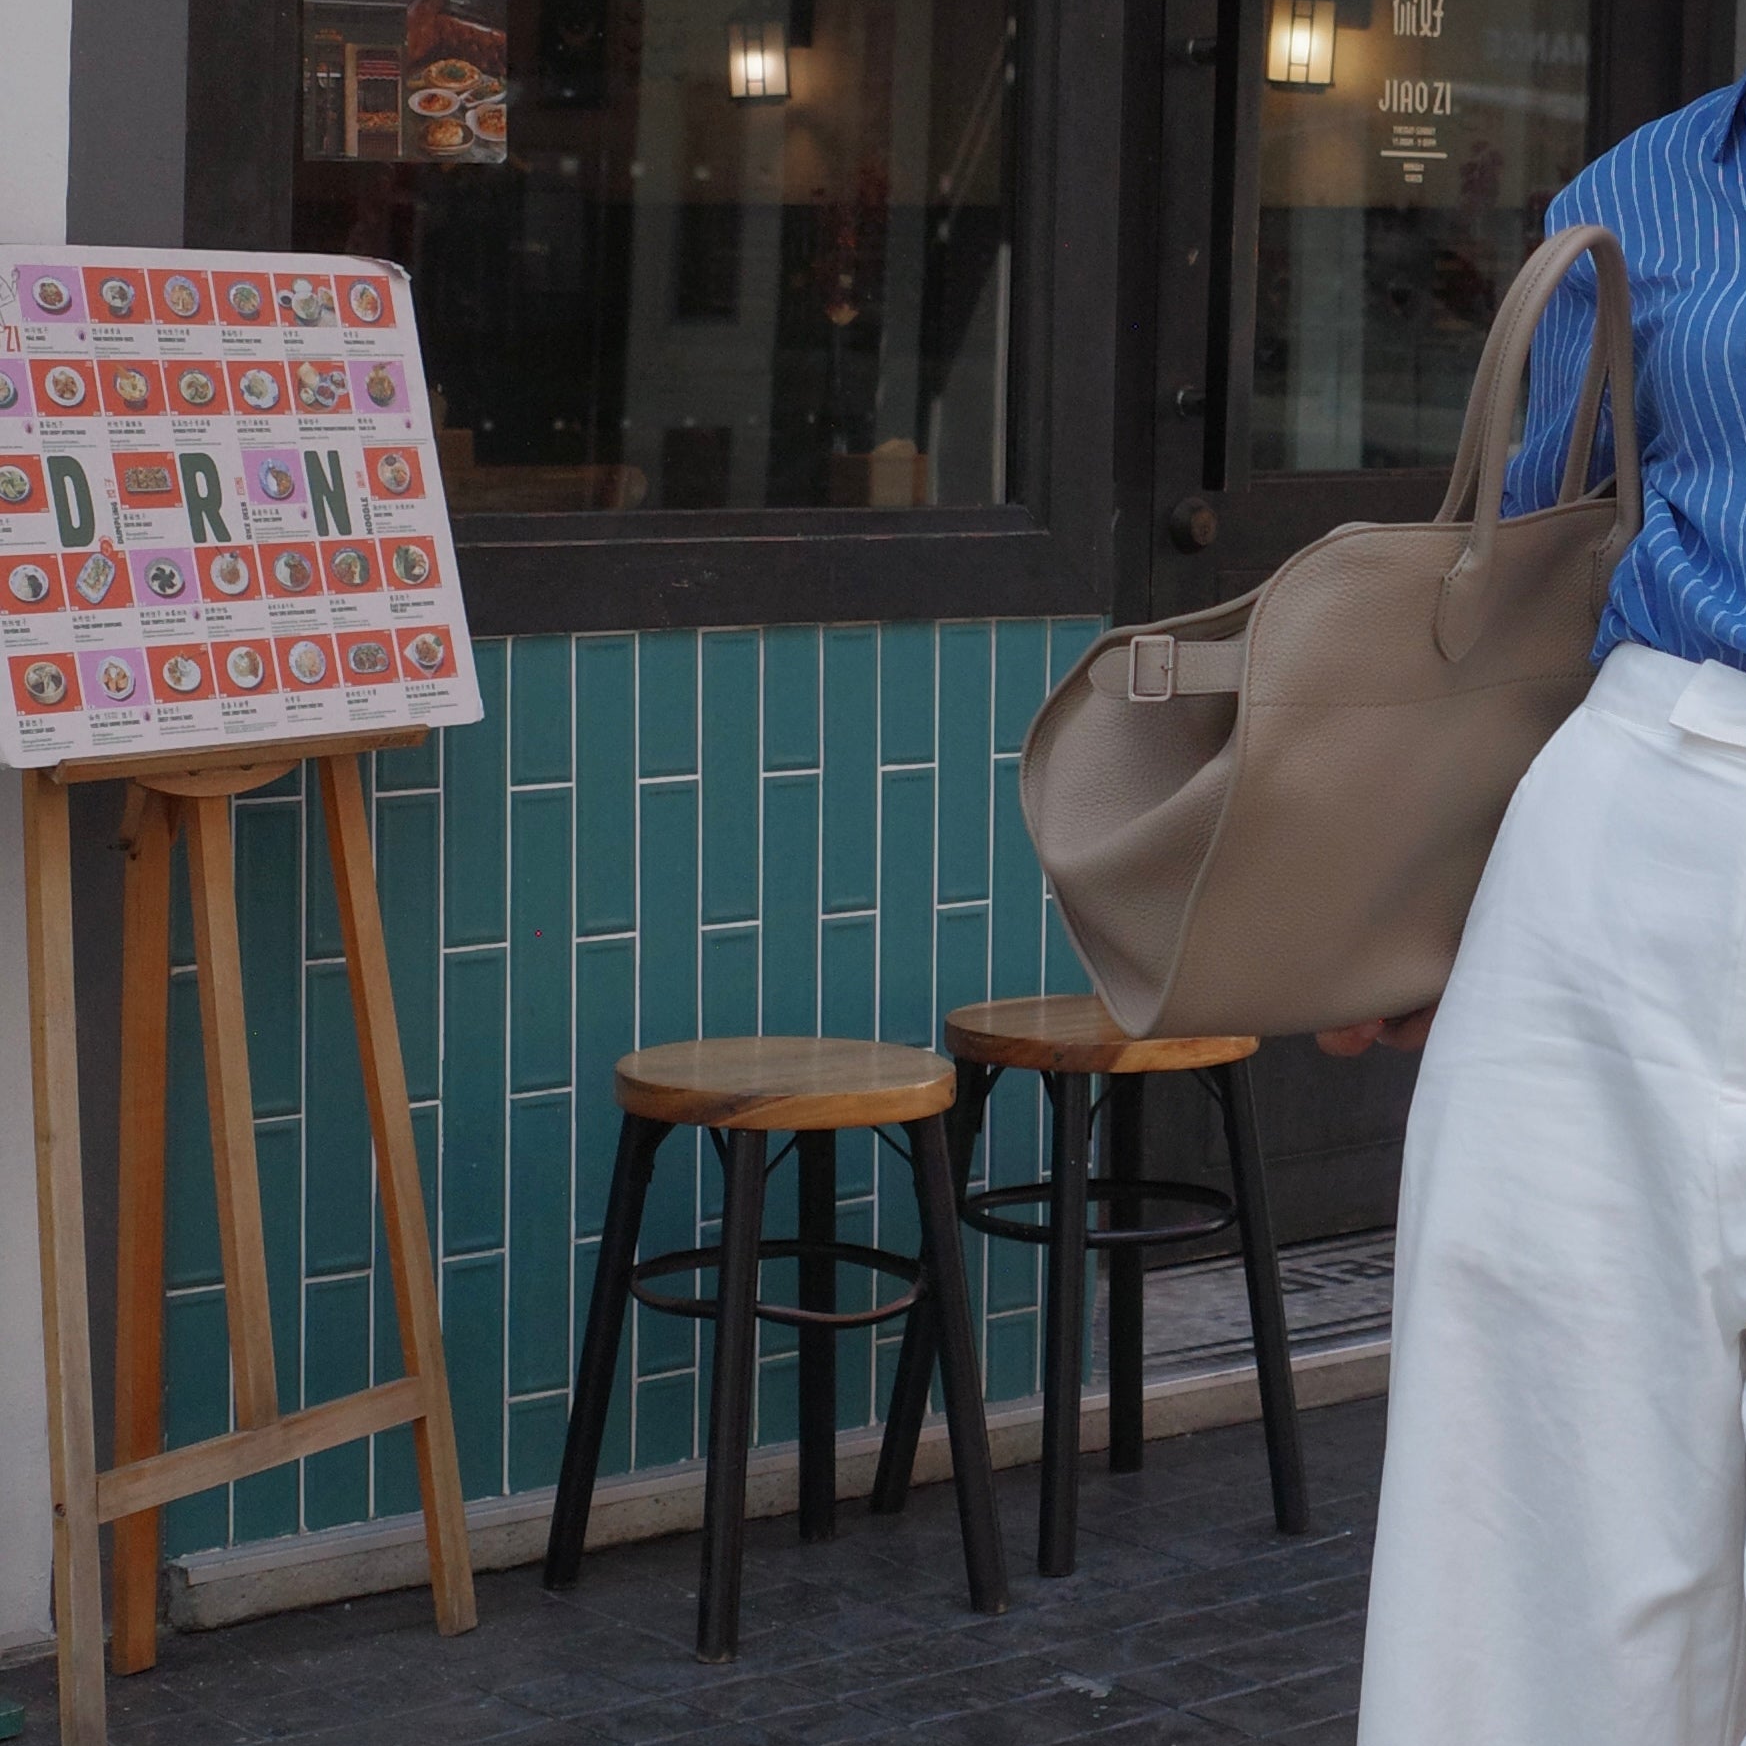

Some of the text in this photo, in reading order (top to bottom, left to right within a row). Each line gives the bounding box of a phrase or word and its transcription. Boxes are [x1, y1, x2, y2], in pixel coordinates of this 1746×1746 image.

[1378, 79, 1452, 115] JIAO ZI
[46, 455, 95, 548] D
[179, 452, 232, 543] R
[304, 450, 352, 537] N
